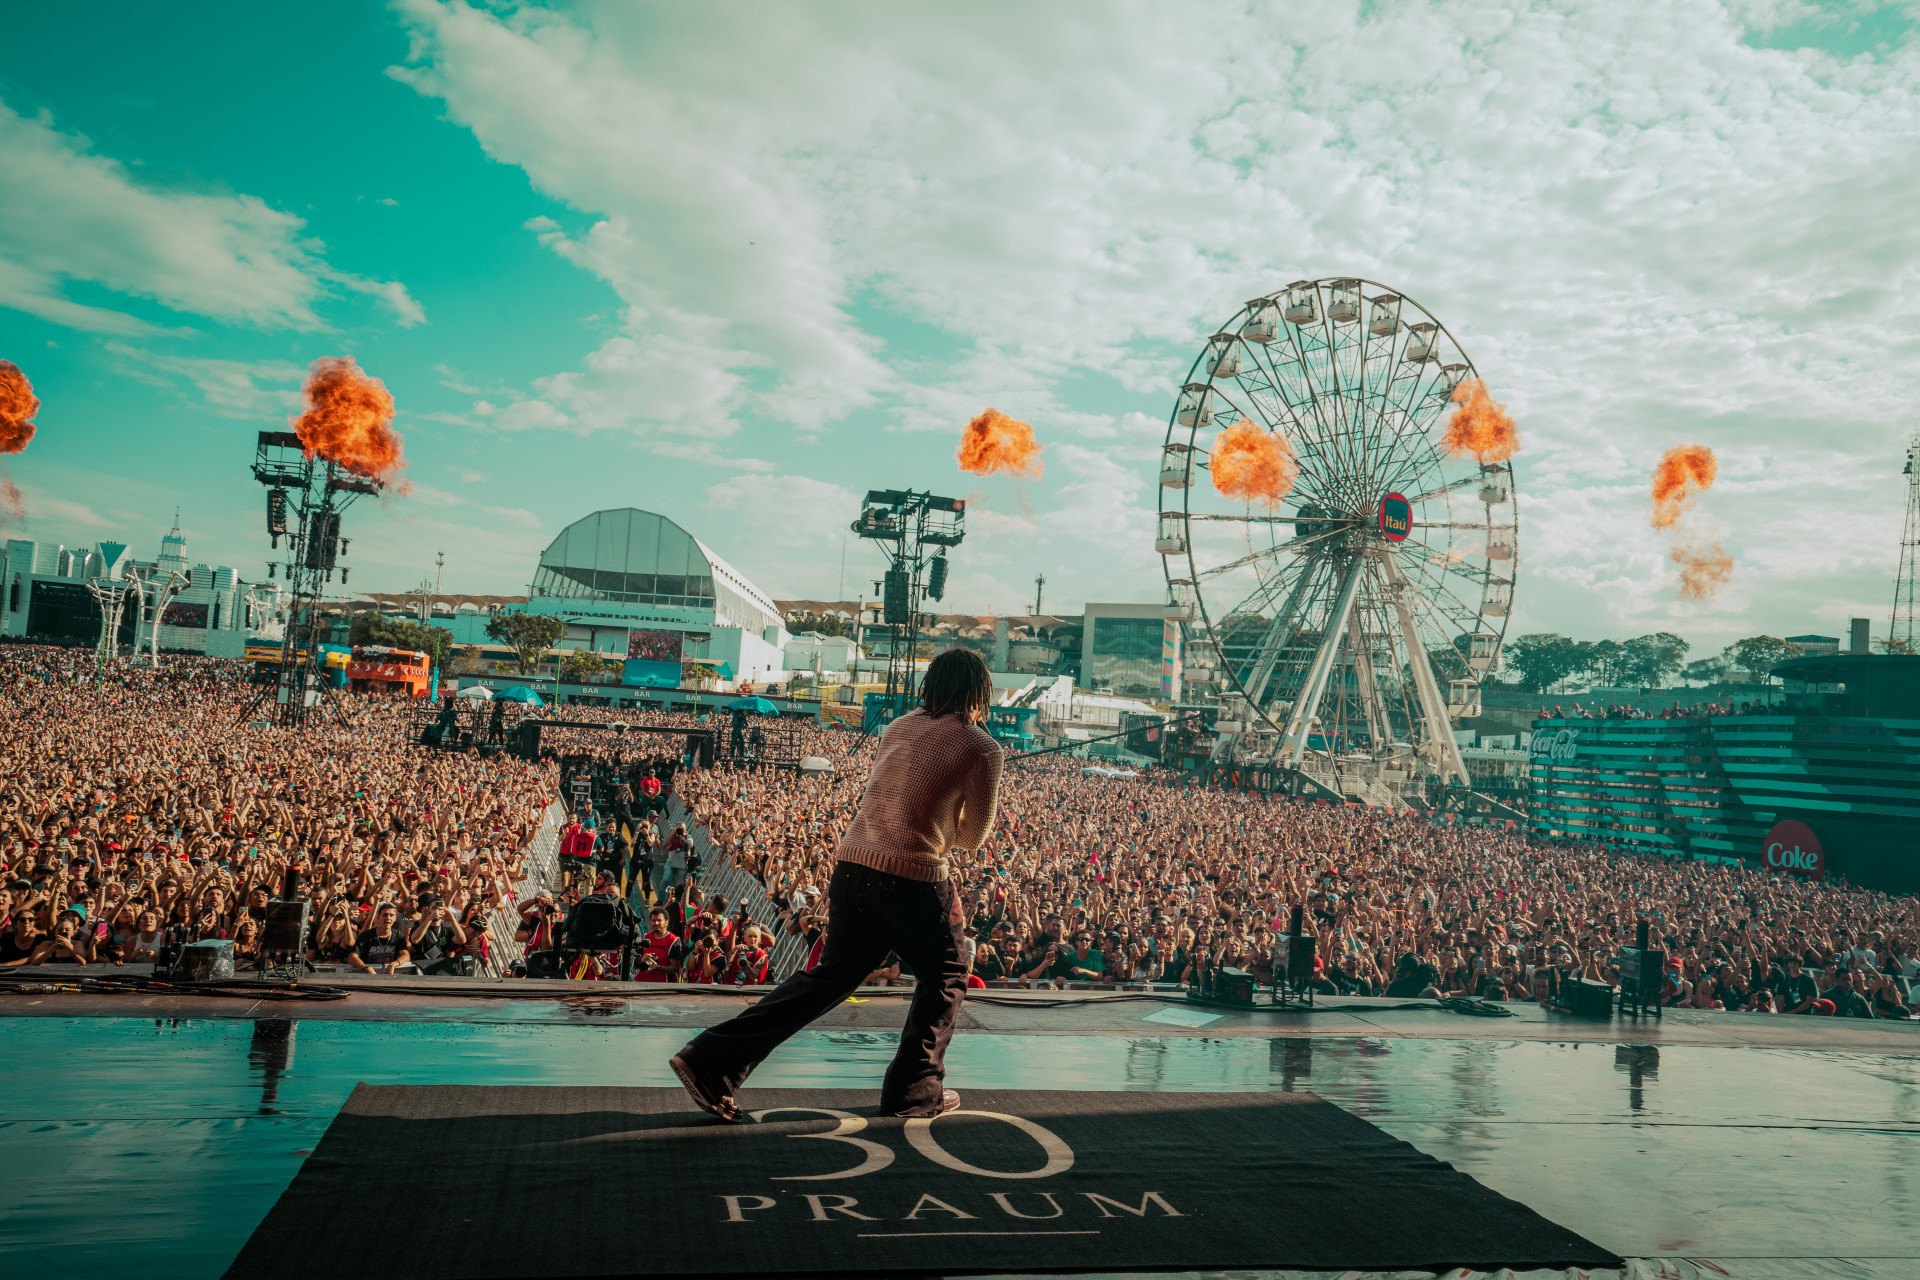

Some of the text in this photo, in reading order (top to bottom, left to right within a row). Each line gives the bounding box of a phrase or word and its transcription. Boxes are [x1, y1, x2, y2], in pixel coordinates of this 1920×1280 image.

[1385, 515, 1406, 530] Itaú
[530, 683, 547, 691] BAR
[786, 702, 803, 710] BAR
[1767, 842, 1818, 870] Coke
[717, 1191, 1192, 1223] PRAUM
